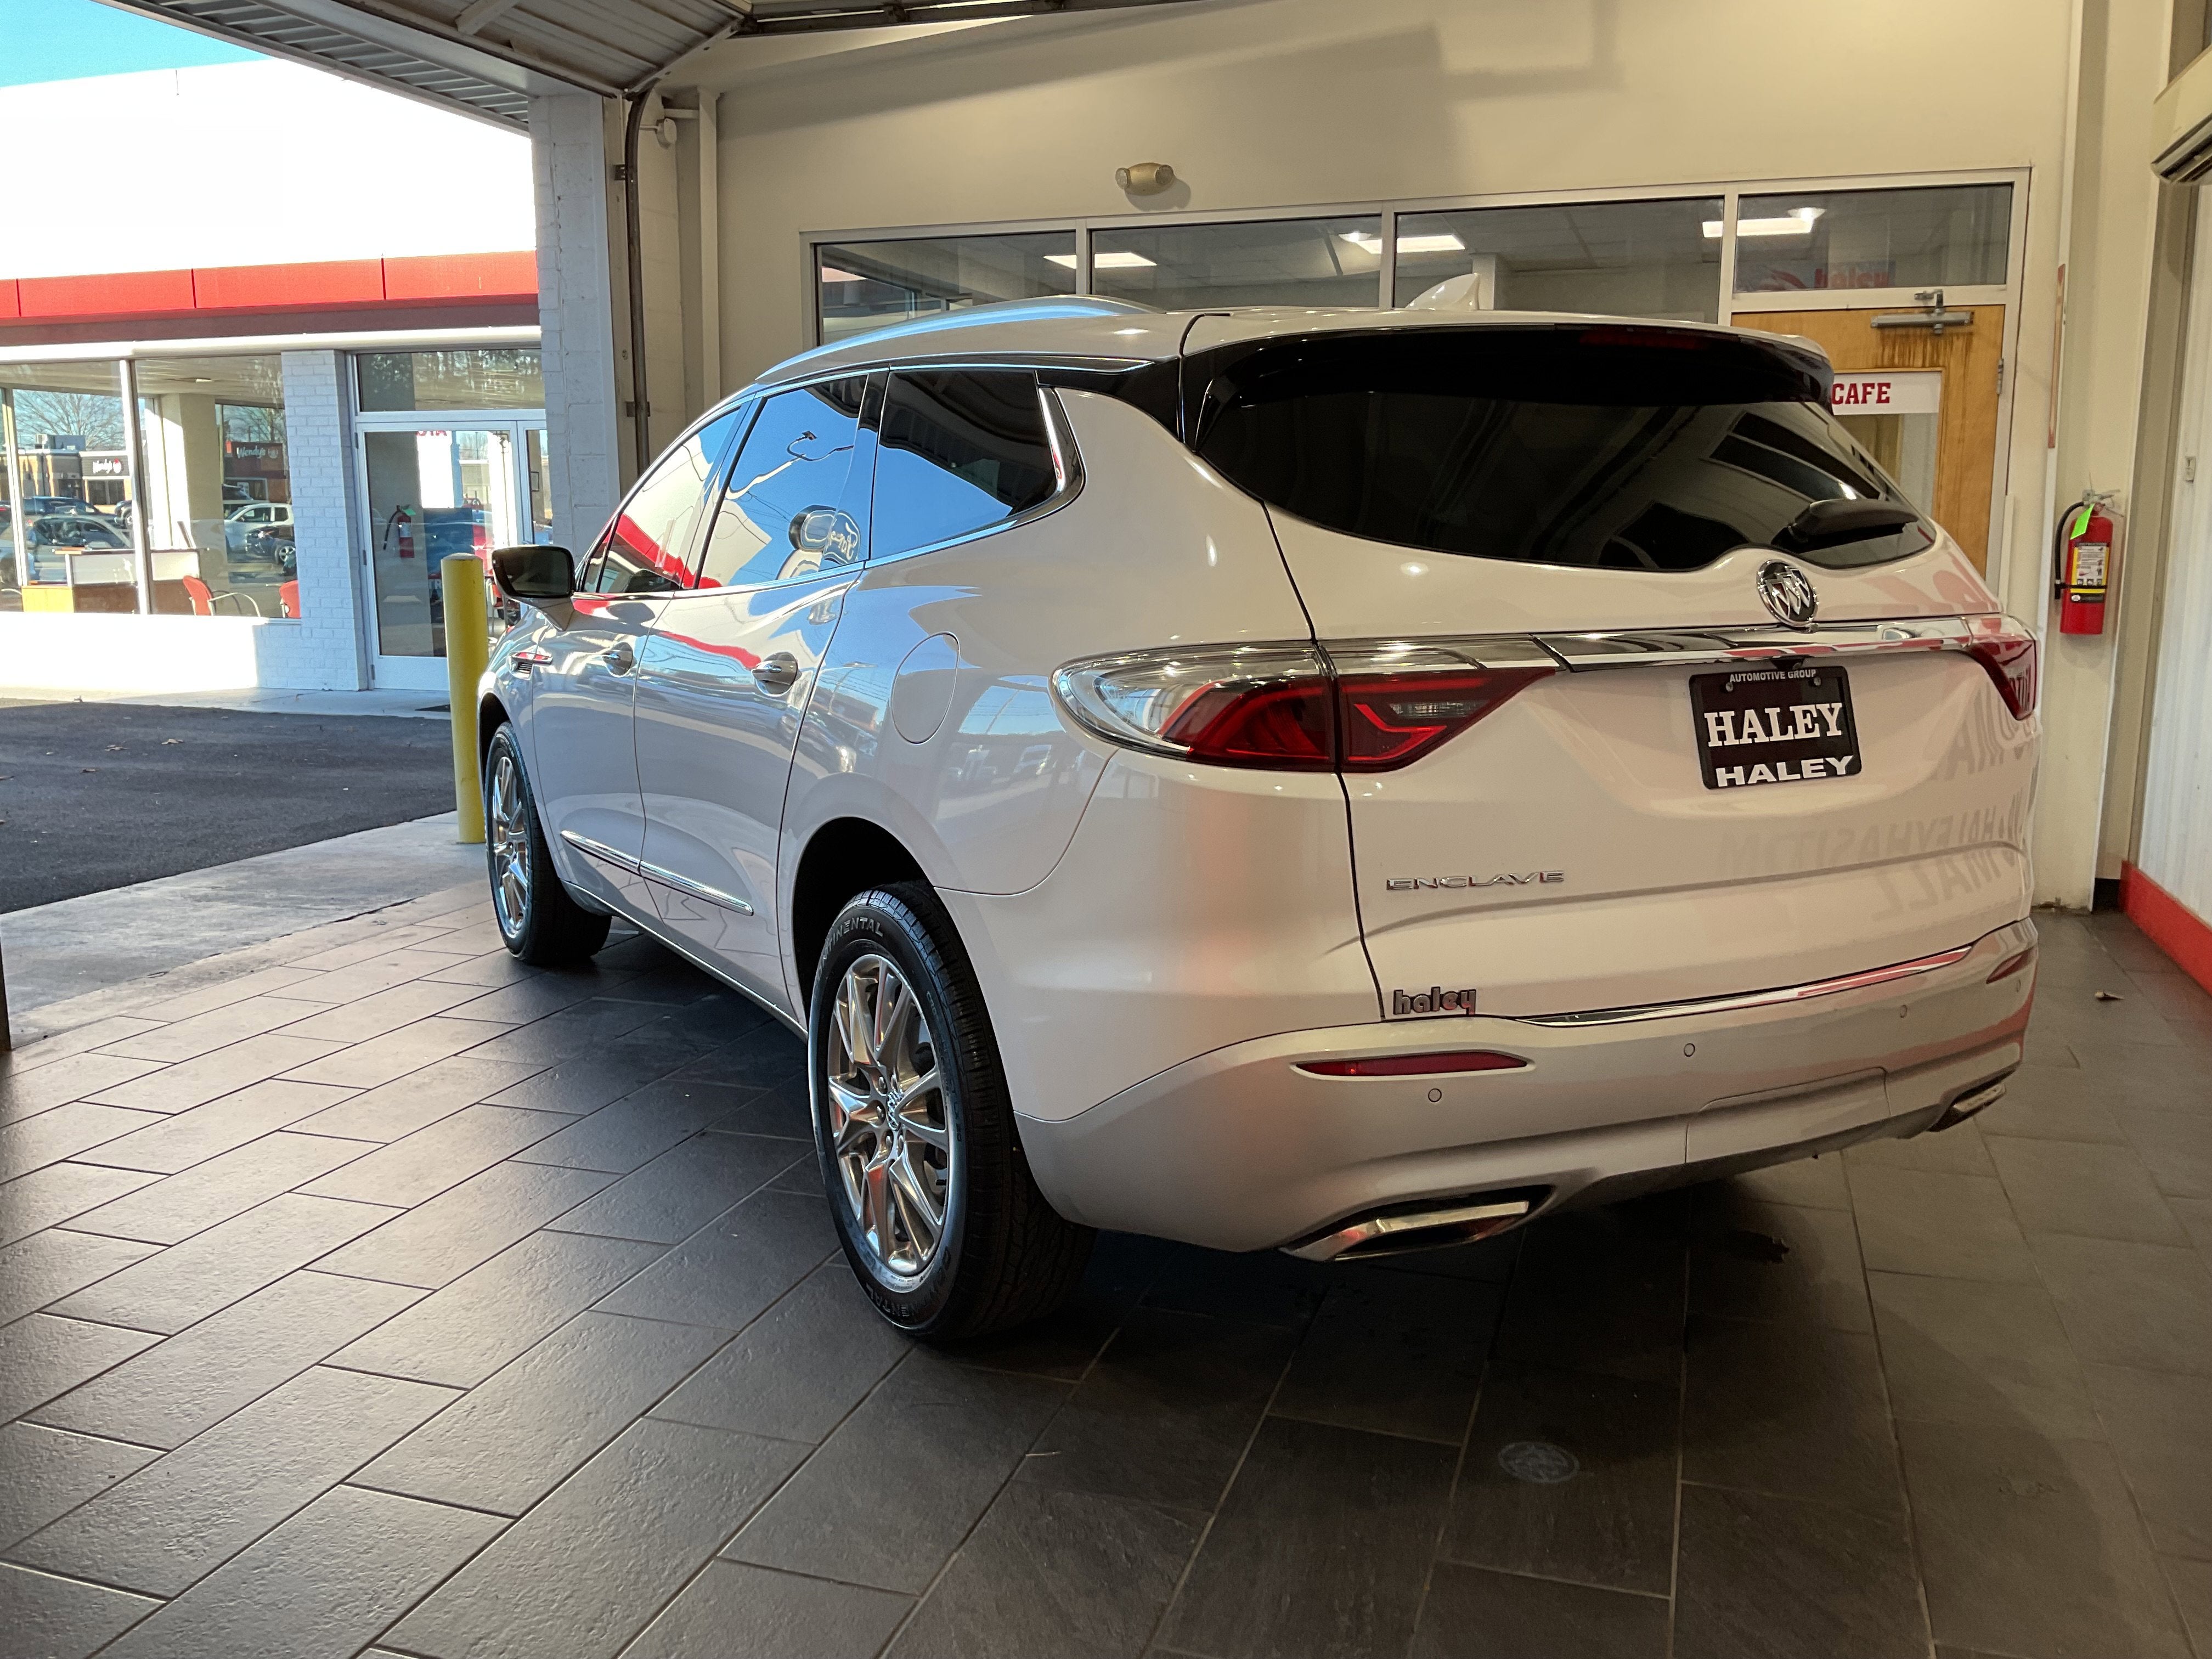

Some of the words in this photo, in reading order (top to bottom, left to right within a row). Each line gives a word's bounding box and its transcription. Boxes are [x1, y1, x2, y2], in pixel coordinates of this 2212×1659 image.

[1831, 382, 1891, 405] CAFE
[1730, 671, 1786, 682] AUTOMOTIVE
[1787, 669, 1816, 679] GROUP
[1704, 702, 1843, 747] HALEY
[1716, 755, 1853, 787] HALEY
[1386, 870, 1564, 890] ENCLAVE
[1393, 986, 1476, 1015] haley
